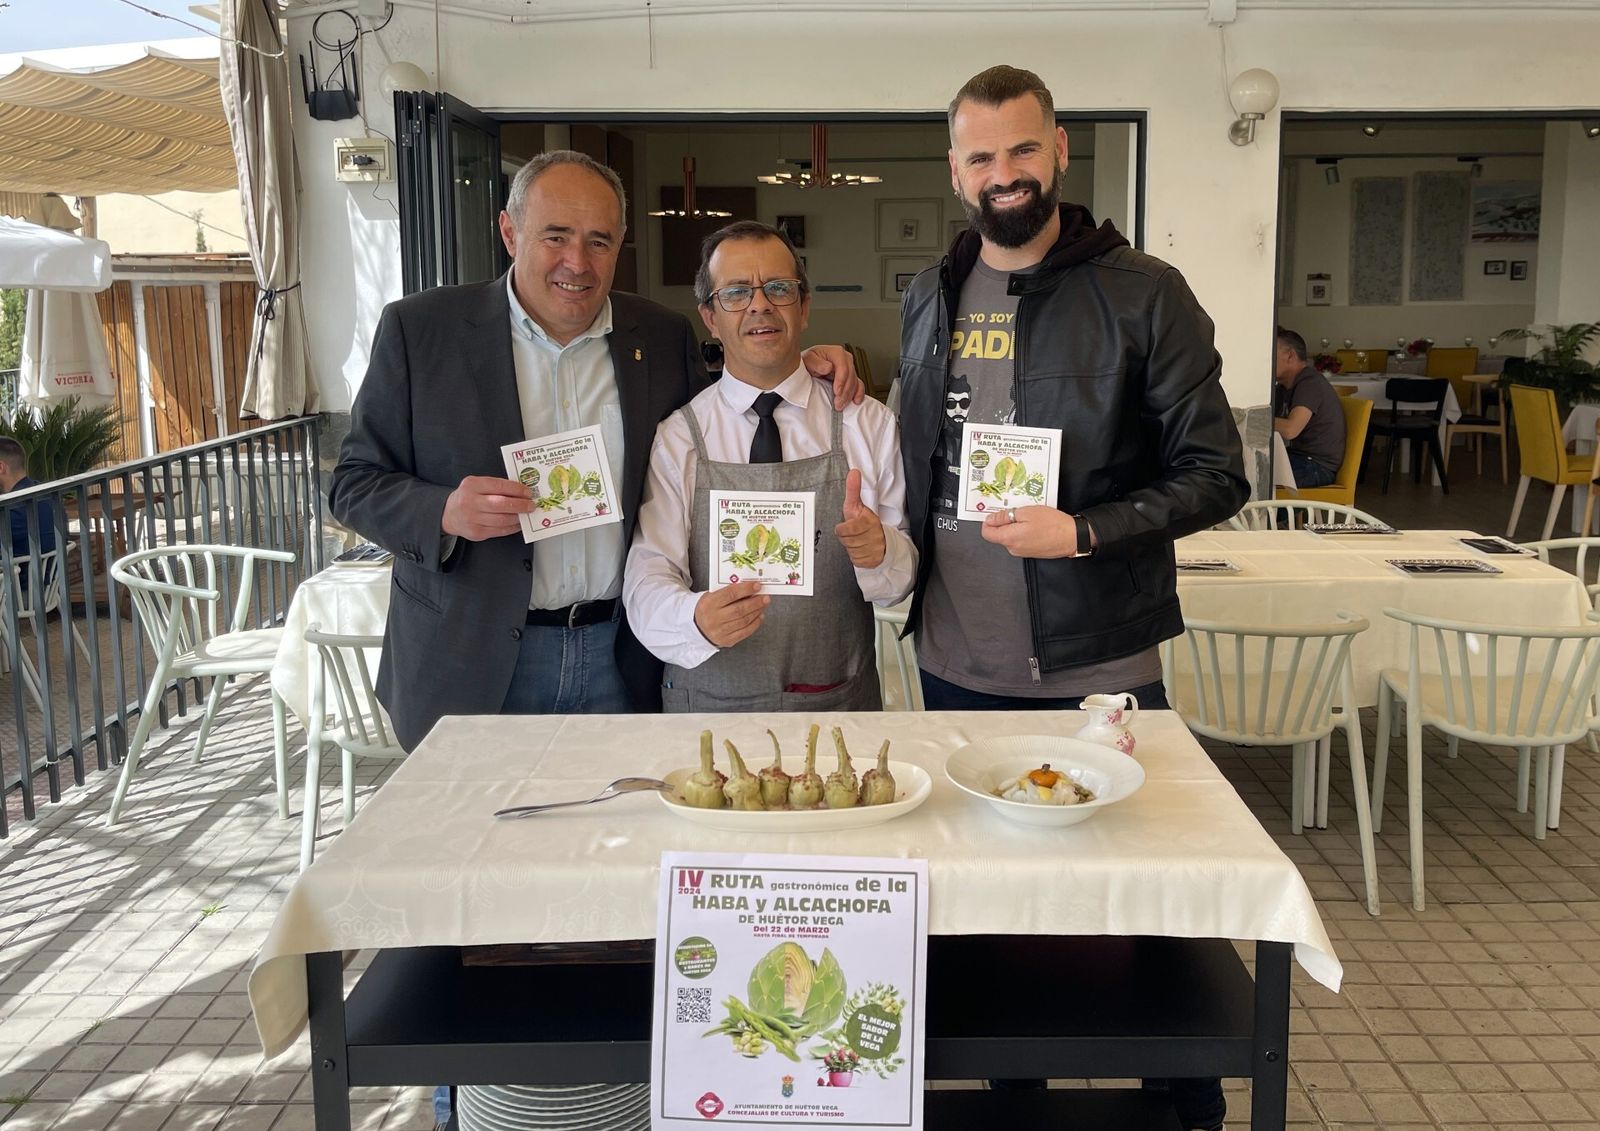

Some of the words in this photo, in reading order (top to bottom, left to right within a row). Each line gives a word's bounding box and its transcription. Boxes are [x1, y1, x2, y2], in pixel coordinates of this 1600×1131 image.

[969, 312, 985, 323] YO
[989, 312, 1014, 323] SOY
[526, 447, 545, 456] RUTA
[549, 445, 588, 458] ALCACHOFA
[1004, 442, 1042, 451] ALCACHOFA
[937, 517, 958, 532] CHUS
[678, 870, 704, 887] IV
[711, 874, 764, 889] RUTA
[770, 881, 849, 891] gastronómica
[855, 877, 881, 892] de
[888, 878, 907, 893] la
[692, 895, 749, 910] HABA
[756, 899, 767, 913] y
[773, 896, 891, 914] ALCACHOFA
[738, 915, 755, 924] DE
[759, 913, 808, 925] HUÉTOR
[812, 916, 844, 926] VEGA
[798, 926, 830, 934] MARZO
[857, 1013, 868, 1022] EL
[869, 1016, 896, 1030] MEJOR
[861, 1022, 889, 1037] SABOR
[860, 1031, 872, 1040] DE
[873, 1035, 884, 1044] LA
[860, 1040, 880, 1052] VEGA
